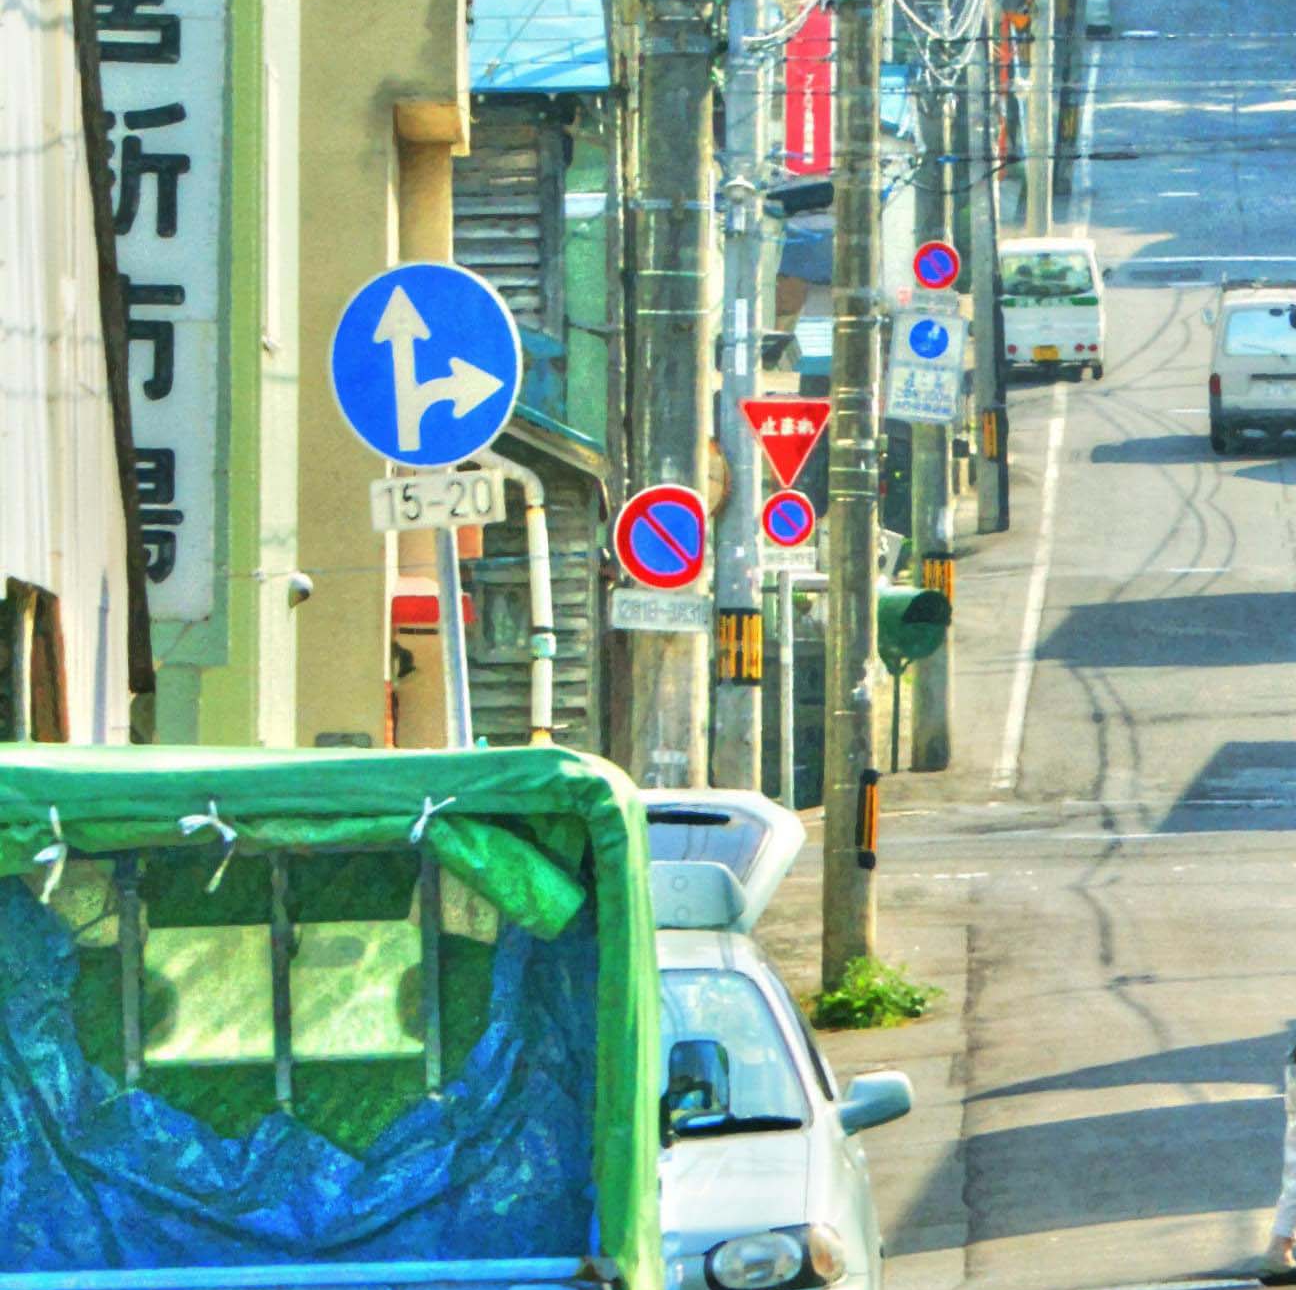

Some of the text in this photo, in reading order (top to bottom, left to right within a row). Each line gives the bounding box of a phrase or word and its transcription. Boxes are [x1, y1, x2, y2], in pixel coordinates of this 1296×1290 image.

[759, 416, 815, 435] 止まれ
[383, 476, 491, 524] 15-20
